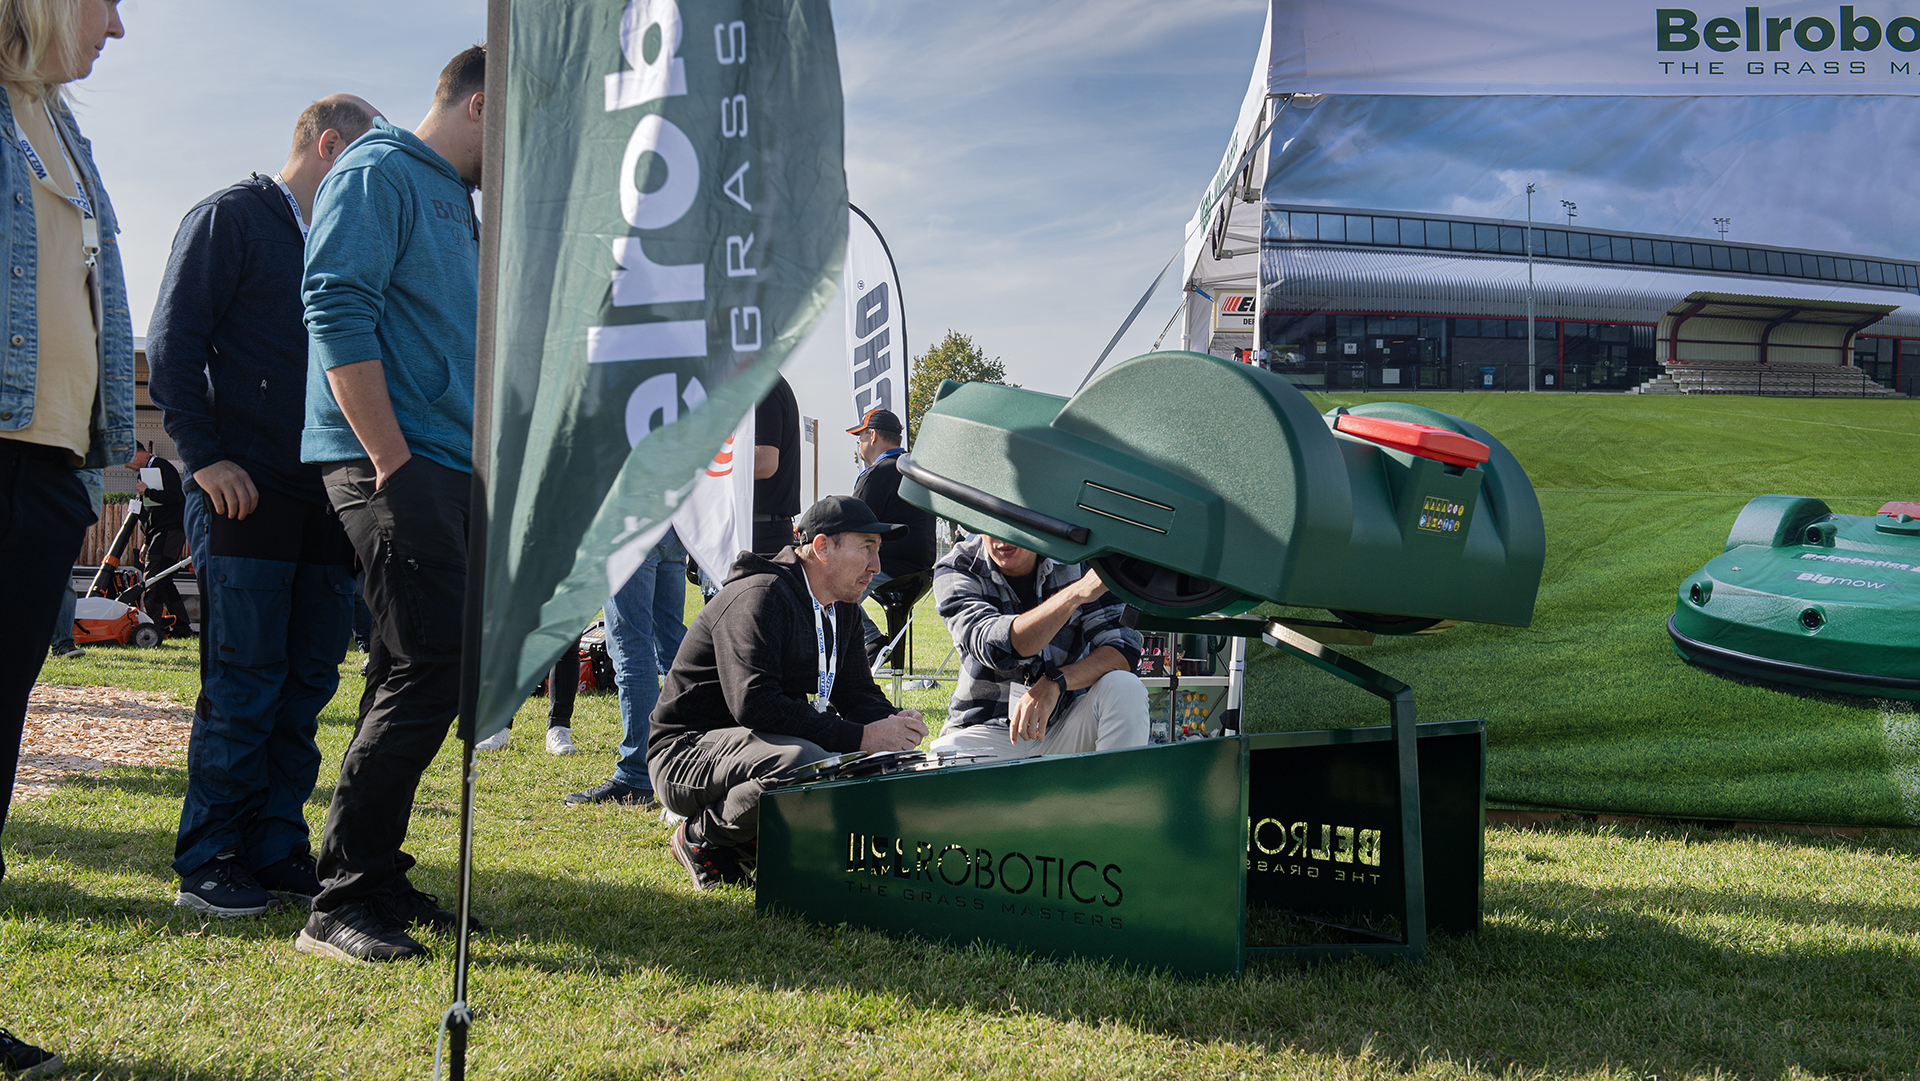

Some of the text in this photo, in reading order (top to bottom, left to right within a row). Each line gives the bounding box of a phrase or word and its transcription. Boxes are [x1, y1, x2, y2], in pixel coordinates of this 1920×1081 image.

[1658, 61, 1920, 75] THE GRASS M
[714, 20, 761, 352] GRASS
[1796, 572, 1885, 589] Bigmow
[845, 832, 1124, 908] BELROBOTICS
[845, 880, 1123, 930] THE GRASS MASTERS
